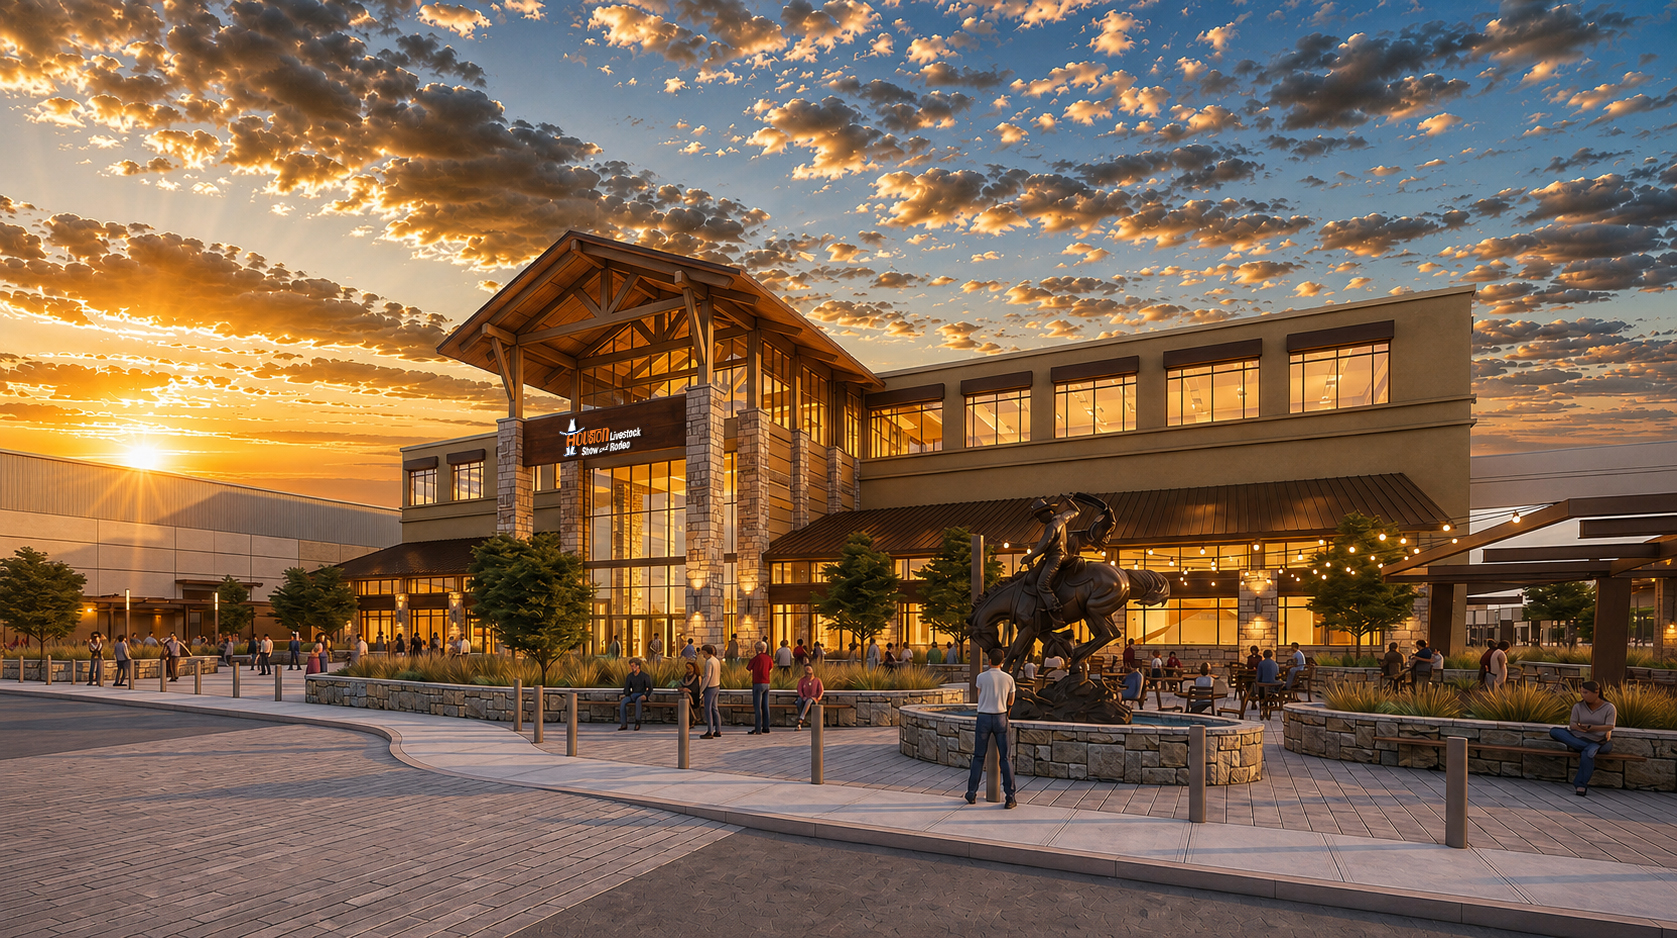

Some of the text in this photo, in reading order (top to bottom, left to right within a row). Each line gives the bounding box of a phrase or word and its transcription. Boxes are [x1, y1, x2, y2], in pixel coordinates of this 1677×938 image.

[610, 427, 641, 441] Livestock
[581, 447, 599, 456] Show
[610, 441, 630, 452] Rodeo
